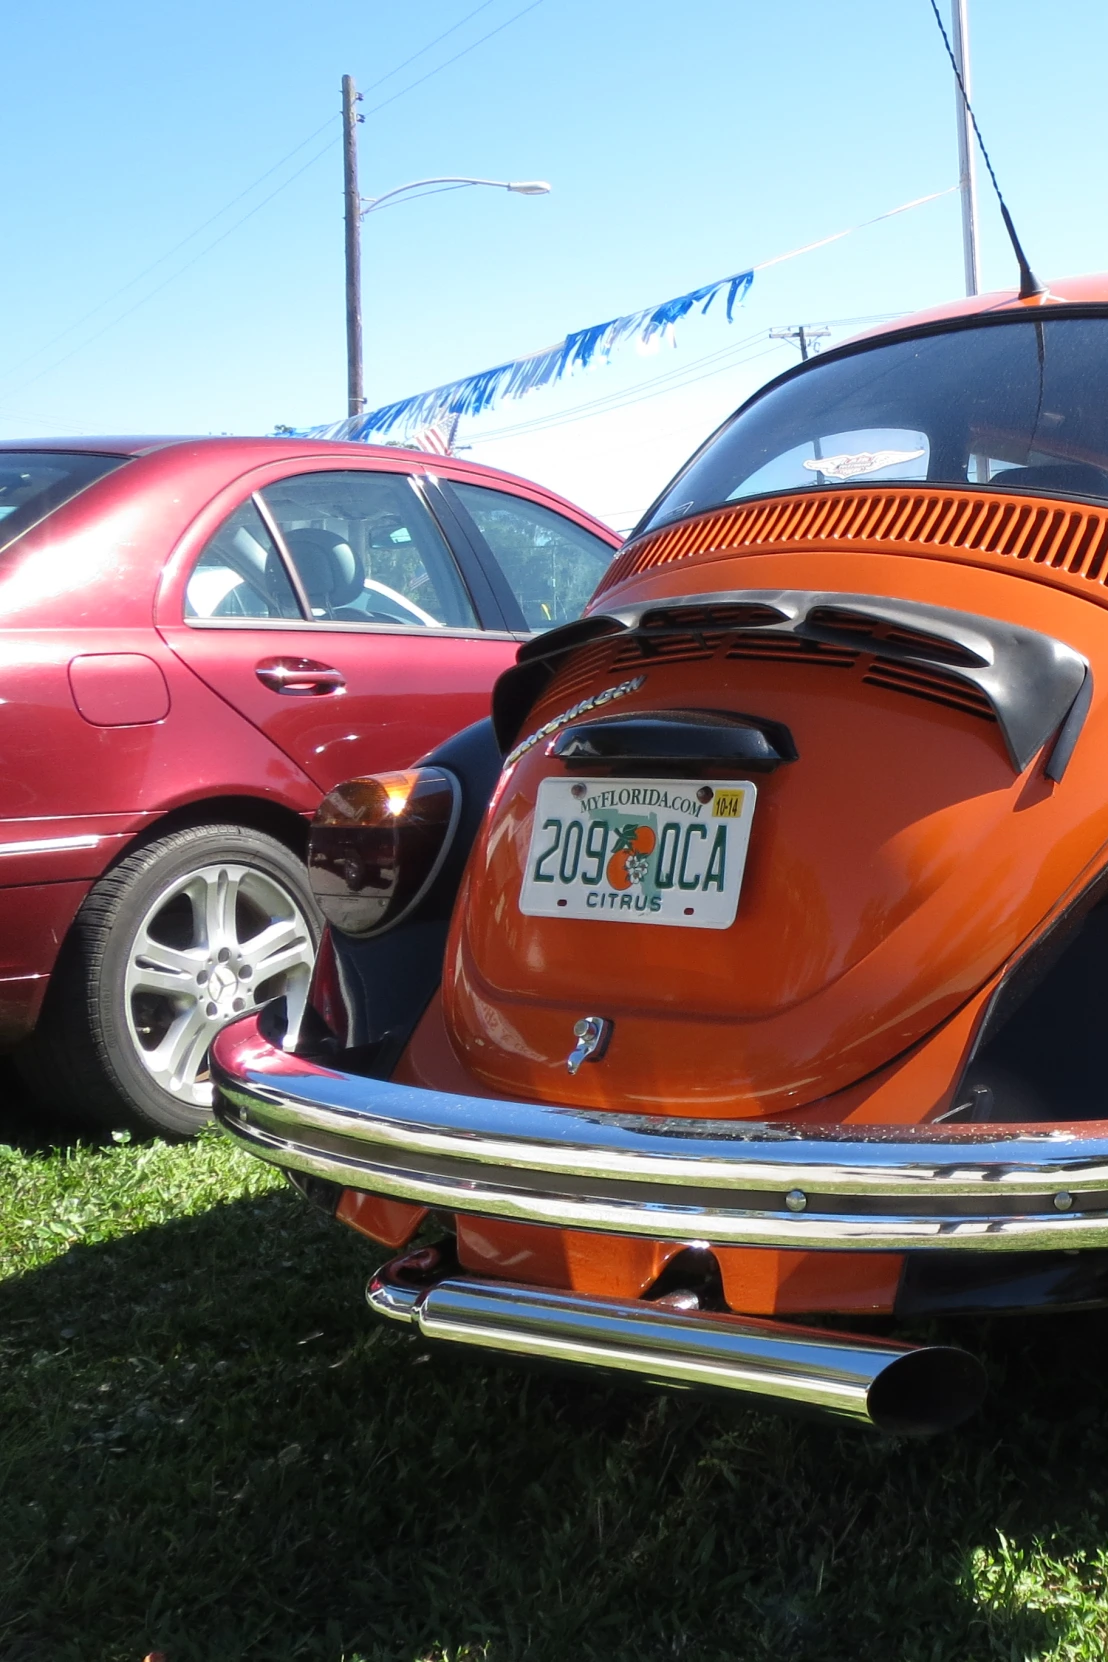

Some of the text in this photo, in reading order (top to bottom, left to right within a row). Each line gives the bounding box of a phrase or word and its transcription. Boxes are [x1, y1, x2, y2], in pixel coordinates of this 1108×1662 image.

[580, 788, 704, 818] MYFLORIDA.COM
[715, 797, 739, 817] 10-14
[534, 819, 729, 893] 209 QCA
[585, 892, 663, 913] CITRUS
